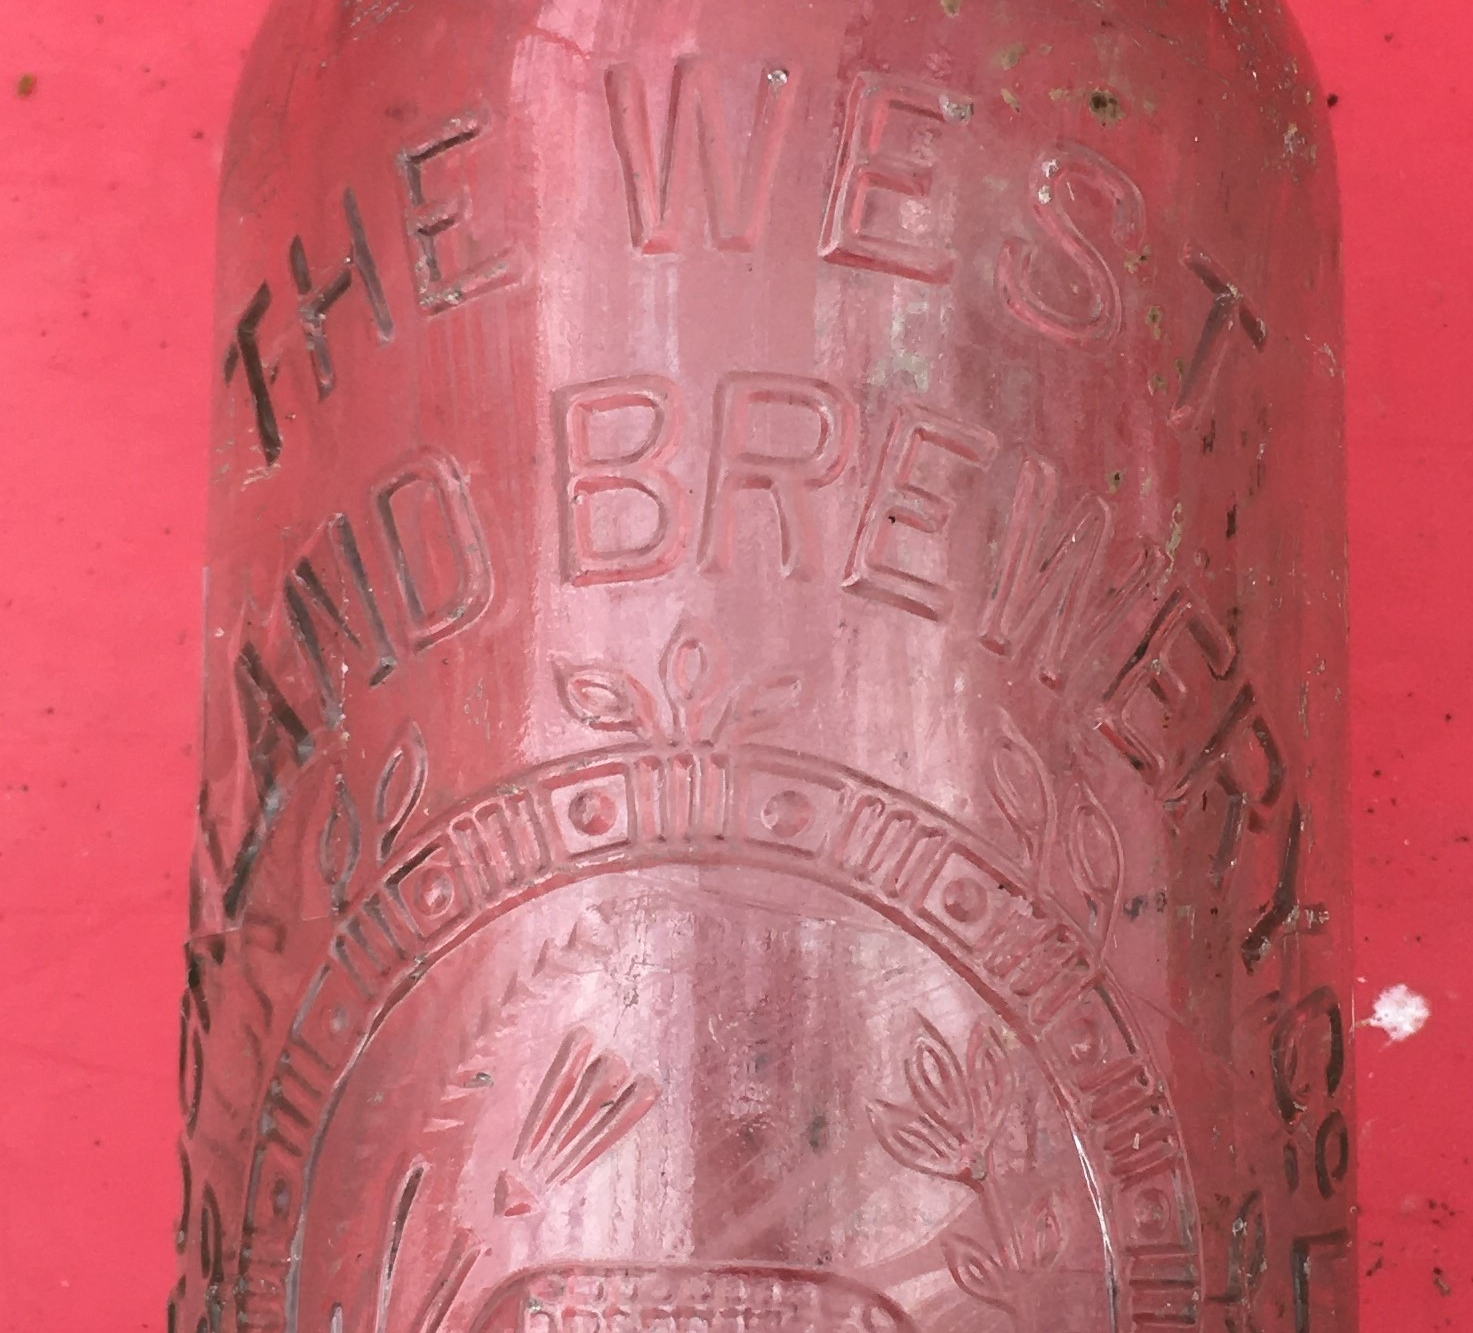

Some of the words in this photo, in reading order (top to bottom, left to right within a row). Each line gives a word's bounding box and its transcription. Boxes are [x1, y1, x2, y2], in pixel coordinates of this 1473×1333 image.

[224, 109, 522, 468] THE
[605, 53, 1267, 427] WEST
[552, 369, 1328, 969] BREWERY
